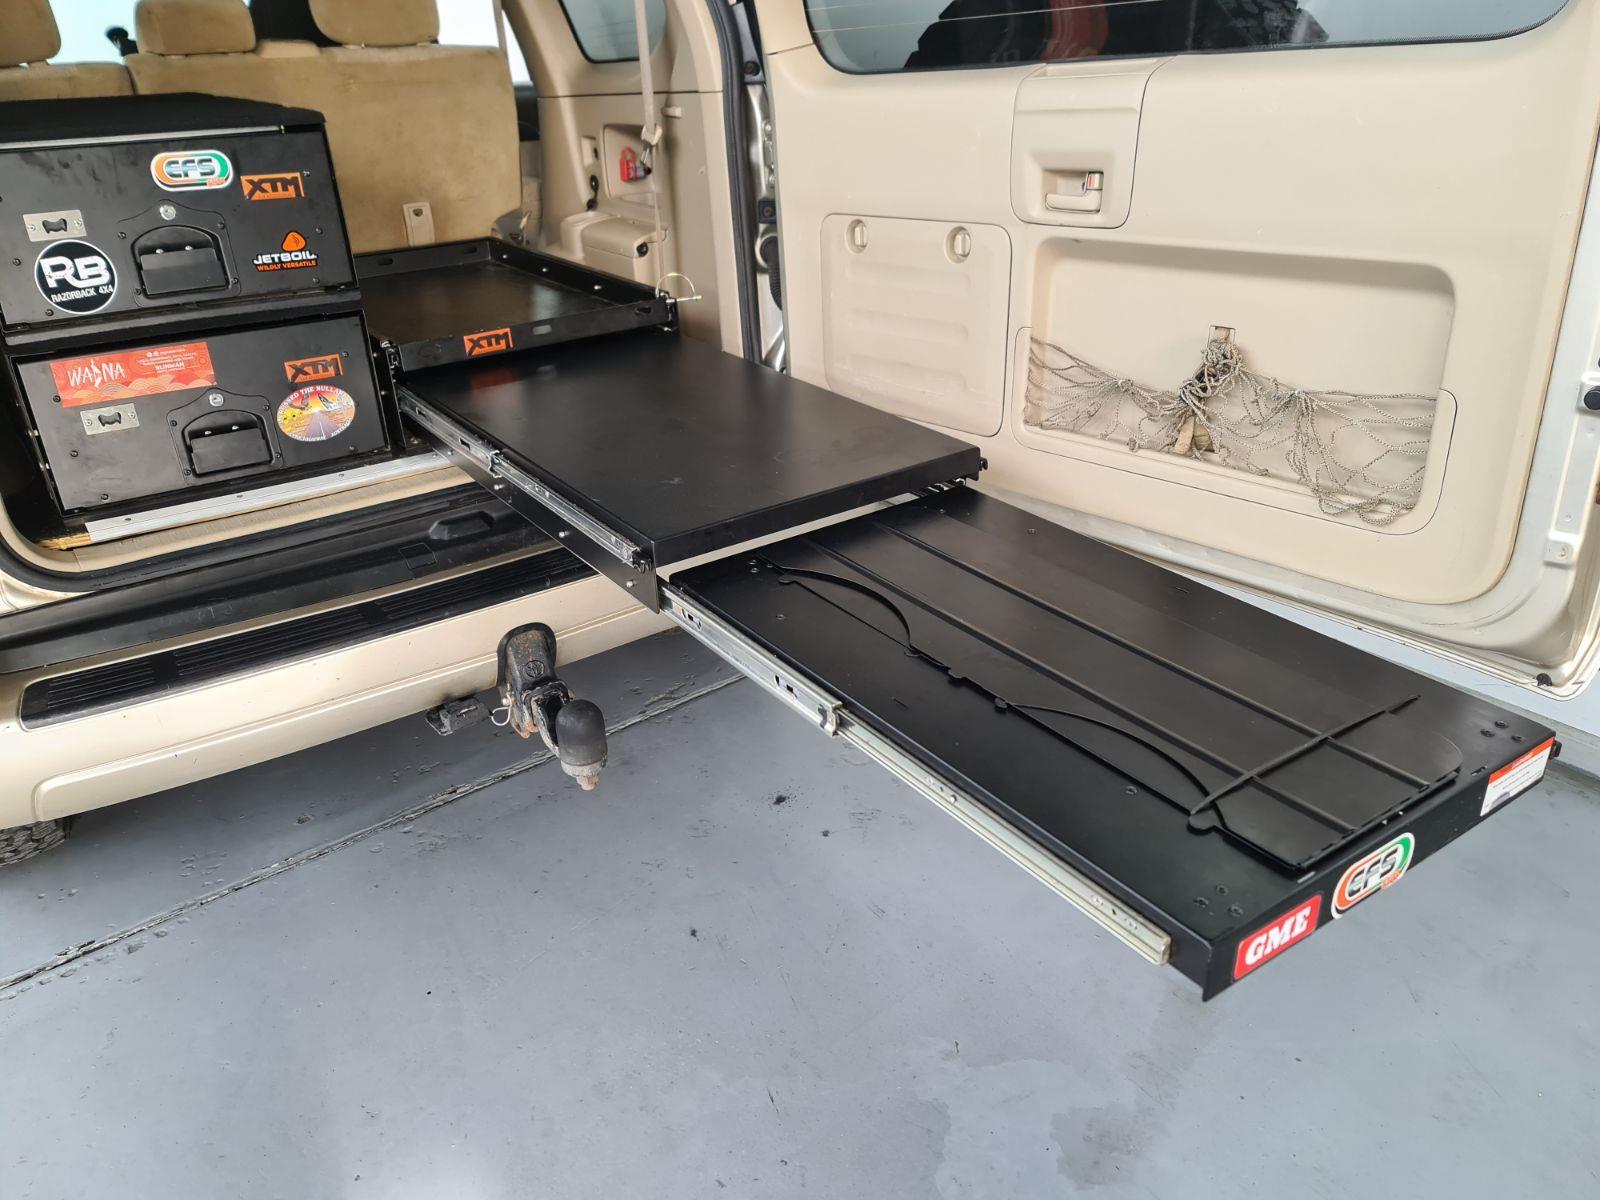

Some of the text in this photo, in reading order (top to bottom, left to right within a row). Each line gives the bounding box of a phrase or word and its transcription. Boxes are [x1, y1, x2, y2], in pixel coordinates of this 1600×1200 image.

[164, 158, 216, 178] EFS
[245, 177, 302, 200] XTM
[253, 251, 317, 265] JETBOIL
[257, 259, 317, 271] WILDLY VERSATILE
[40, 255, 111, 288] RB
[51, 284, 113, 302] RAZORBACK 4X4
[466, 332, 510, 359] XTM
[287, 358, 340, 385] XTM
[300, 386, 315, 395] THE
[1347, 847, 1400, 898] EFS
[1245, 906, 1311, 966] GME
